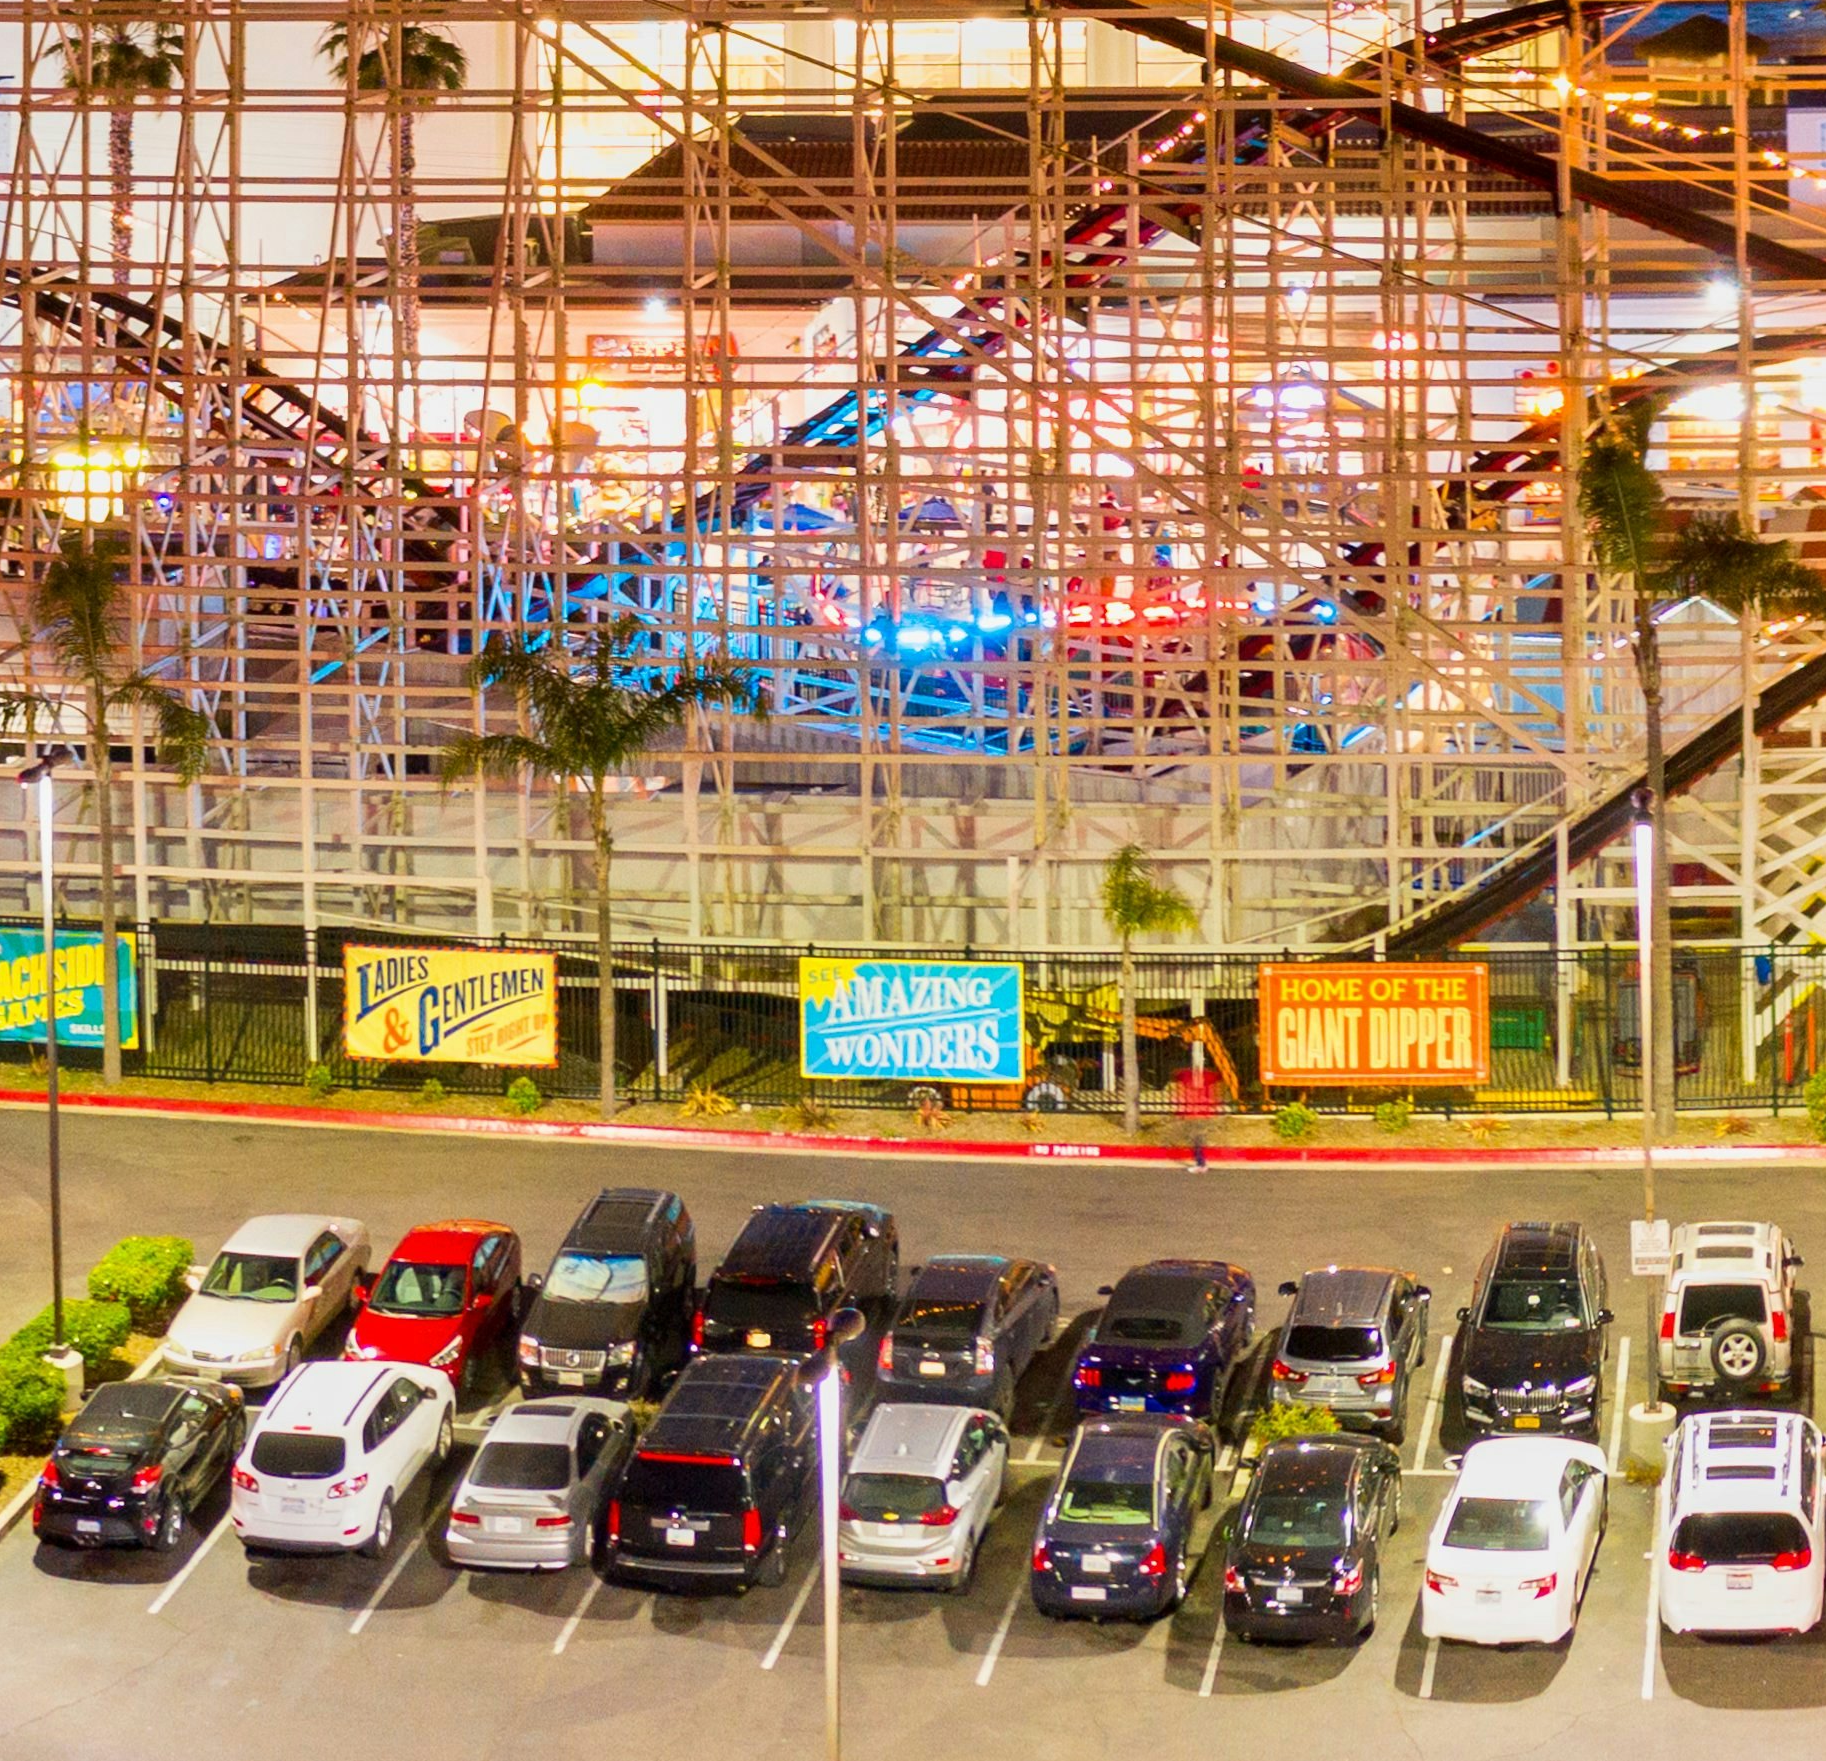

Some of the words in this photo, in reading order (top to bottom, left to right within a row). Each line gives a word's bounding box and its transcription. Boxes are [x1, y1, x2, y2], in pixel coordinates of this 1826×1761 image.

[356, 956, 429, 1024] LADIES
[808, 966, 843, 984] SEE
[825, 975, 994, 1024] AMAZING
[1280, 978, 1363, 1002] HOME
[1369, 978, 1407, 1002] OF
[1414, 978, 1468, 1001] THE
[383, 1007, 412, 1054] &
[419, 968, 544, 1056] GENTLEMEN
[824, 1019, 1000, 1071] WONDERS
[1277, 1007, 1363, 1070] GIANT
[1369, 1007, 1473, 1069] DIPPER
